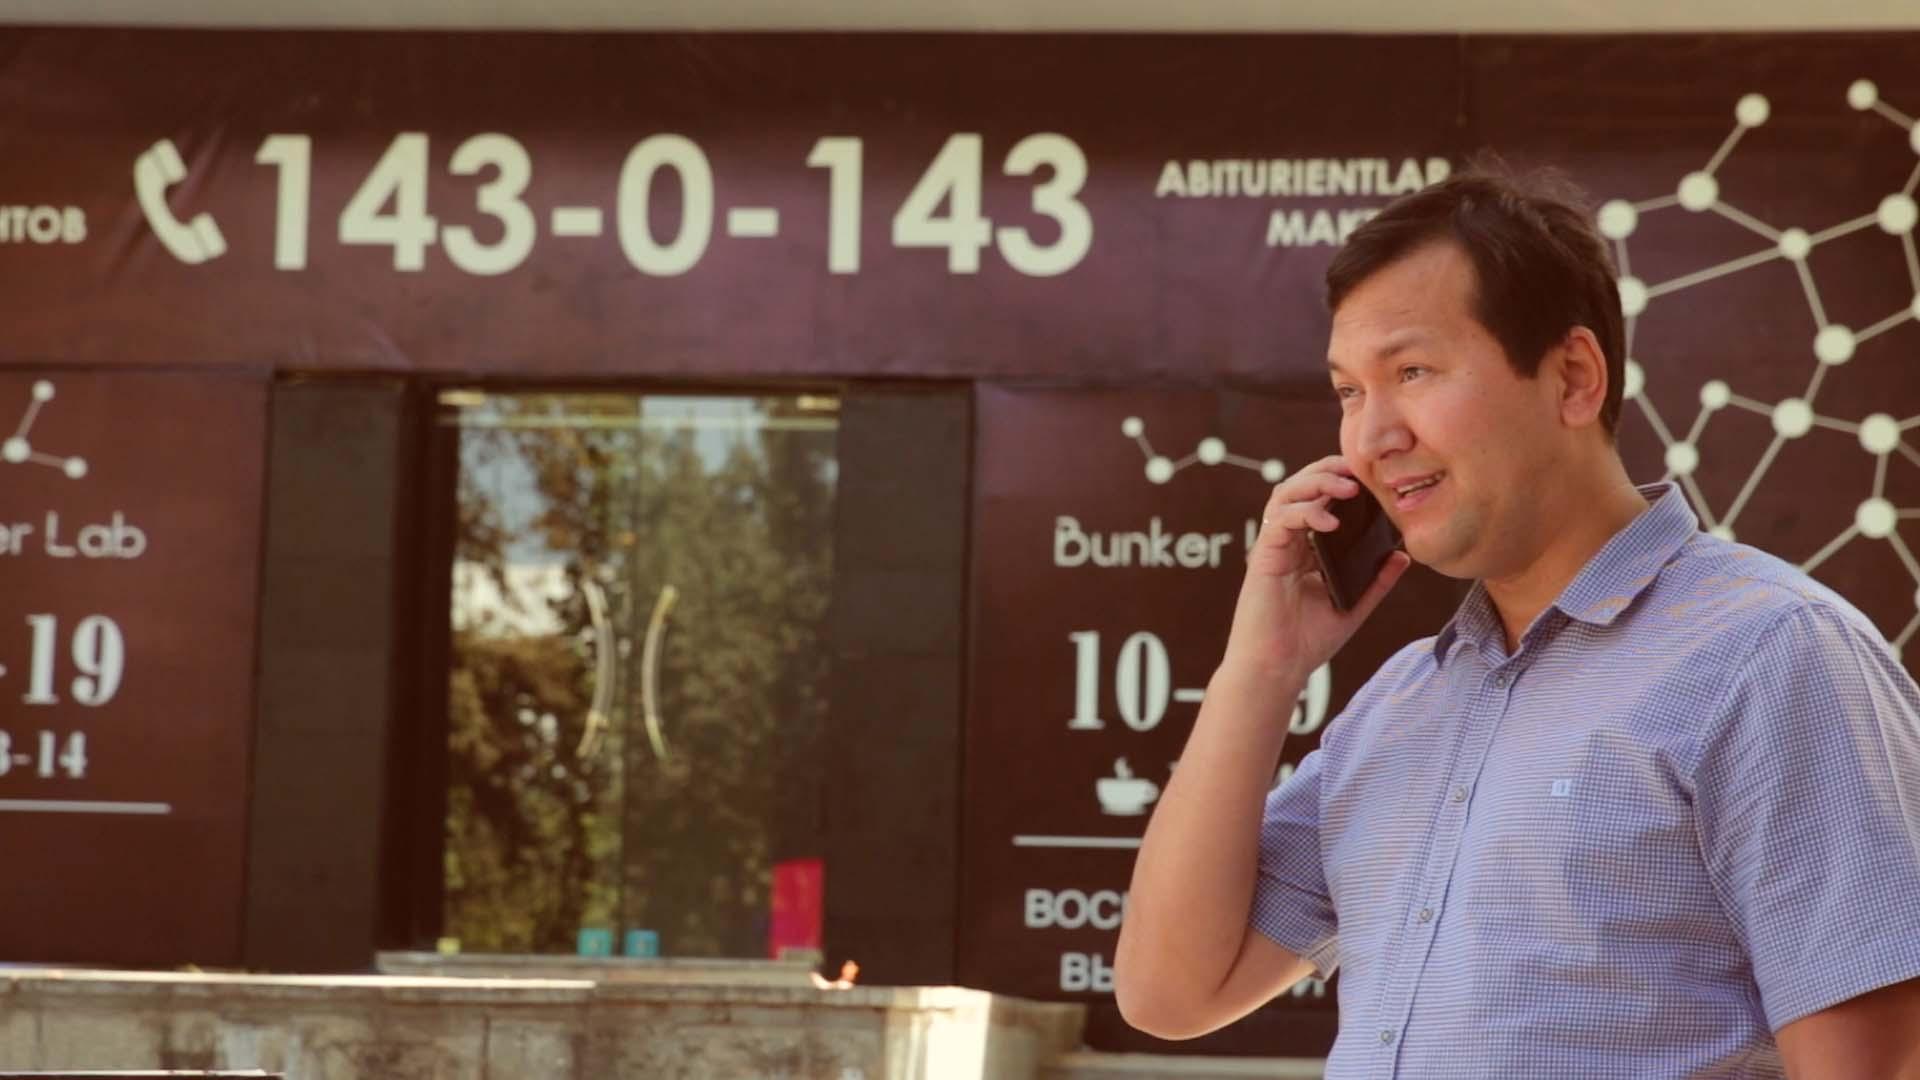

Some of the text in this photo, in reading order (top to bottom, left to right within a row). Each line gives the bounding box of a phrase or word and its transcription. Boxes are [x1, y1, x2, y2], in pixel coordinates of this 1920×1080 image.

[255, 131, 1093, 276] 143-0-143
[45, 509, 147, 559] Lab
[1054, 515, 1233, 568] Bunker
[0, 613, 125, 707] 19
